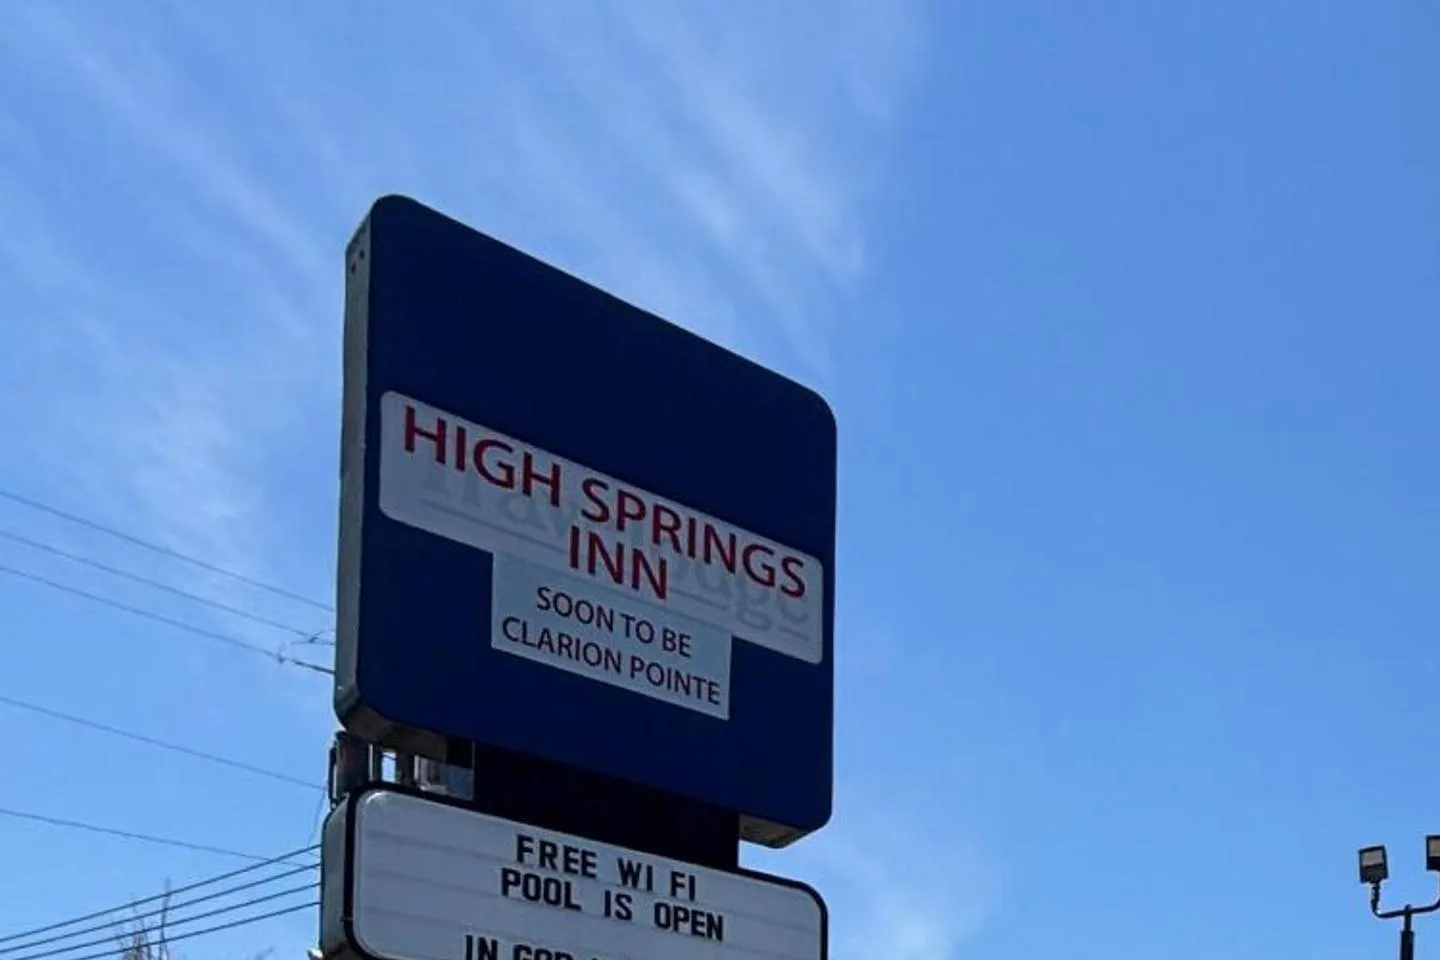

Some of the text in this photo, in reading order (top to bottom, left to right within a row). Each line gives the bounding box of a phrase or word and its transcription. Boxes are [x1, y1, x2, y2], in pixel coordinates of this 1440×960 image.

[404, 405, 561, 507] HIGH
[580, 477, 807, 599] SPRINGS
[568, 525, 669, 600] INN
[536, 586, 692, 658] SOON TO BE
[502, 616, 721, 706] CLARION POINTE
[517, 834, 598, 879] FREE
[501, 867, 724, 942] POOL IS OPEN
